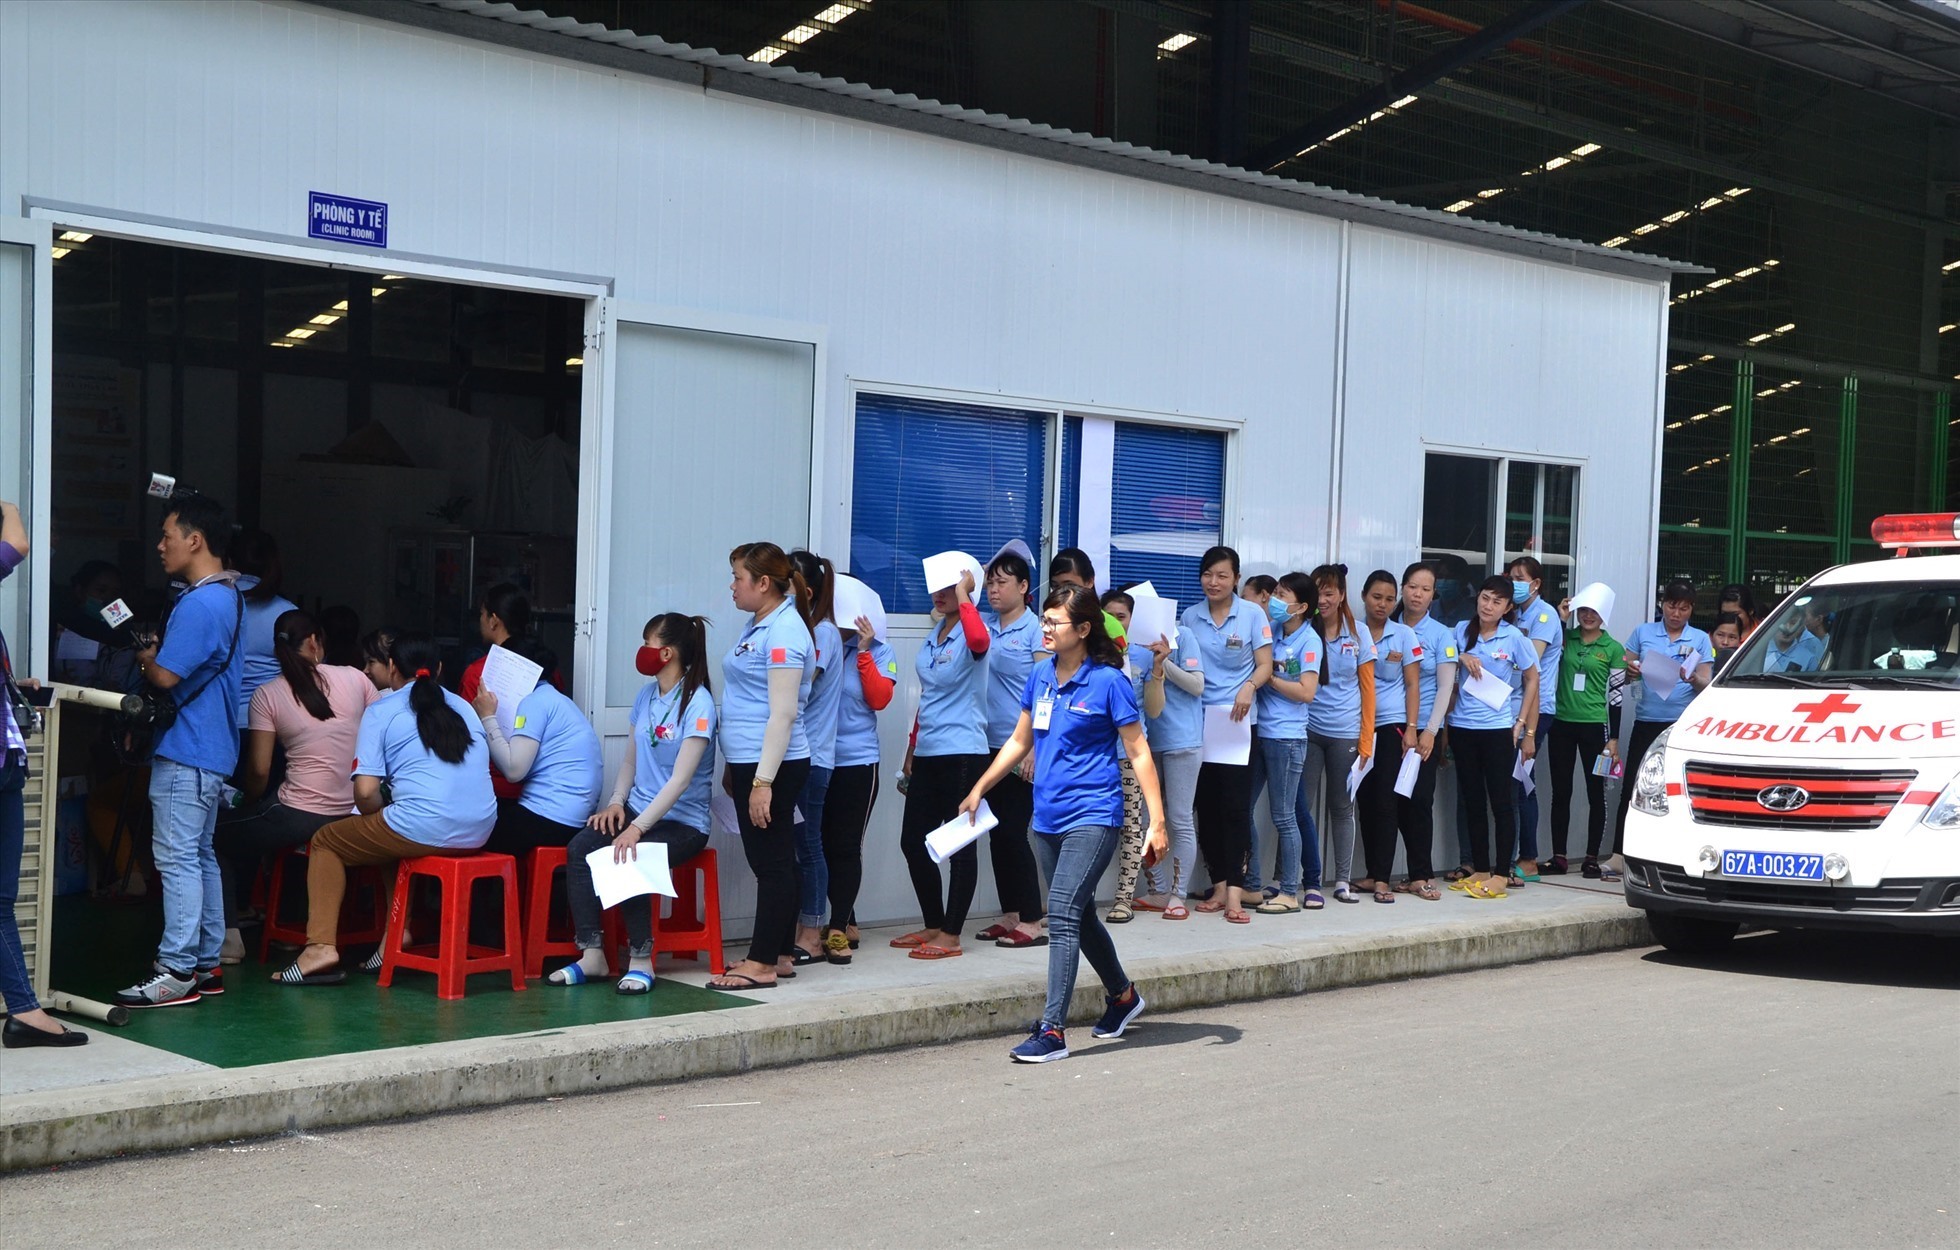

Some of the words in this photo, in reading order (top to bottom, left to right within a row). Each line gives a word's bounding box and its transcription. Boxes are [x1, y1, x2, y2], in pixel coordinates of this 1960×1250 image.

[313, 202, 355, 225] PHÒNG
[358, 209, 366, 226] Y
[368, 207, 384, 229] TẾ
[321, 223, 350, 236] (CLINIC
[350, 227, 375, 241] ROOM)
[1685, 716, 1957, 744] AMBULANCE
[1725, 852, 1821, 878] 67A-003.27
